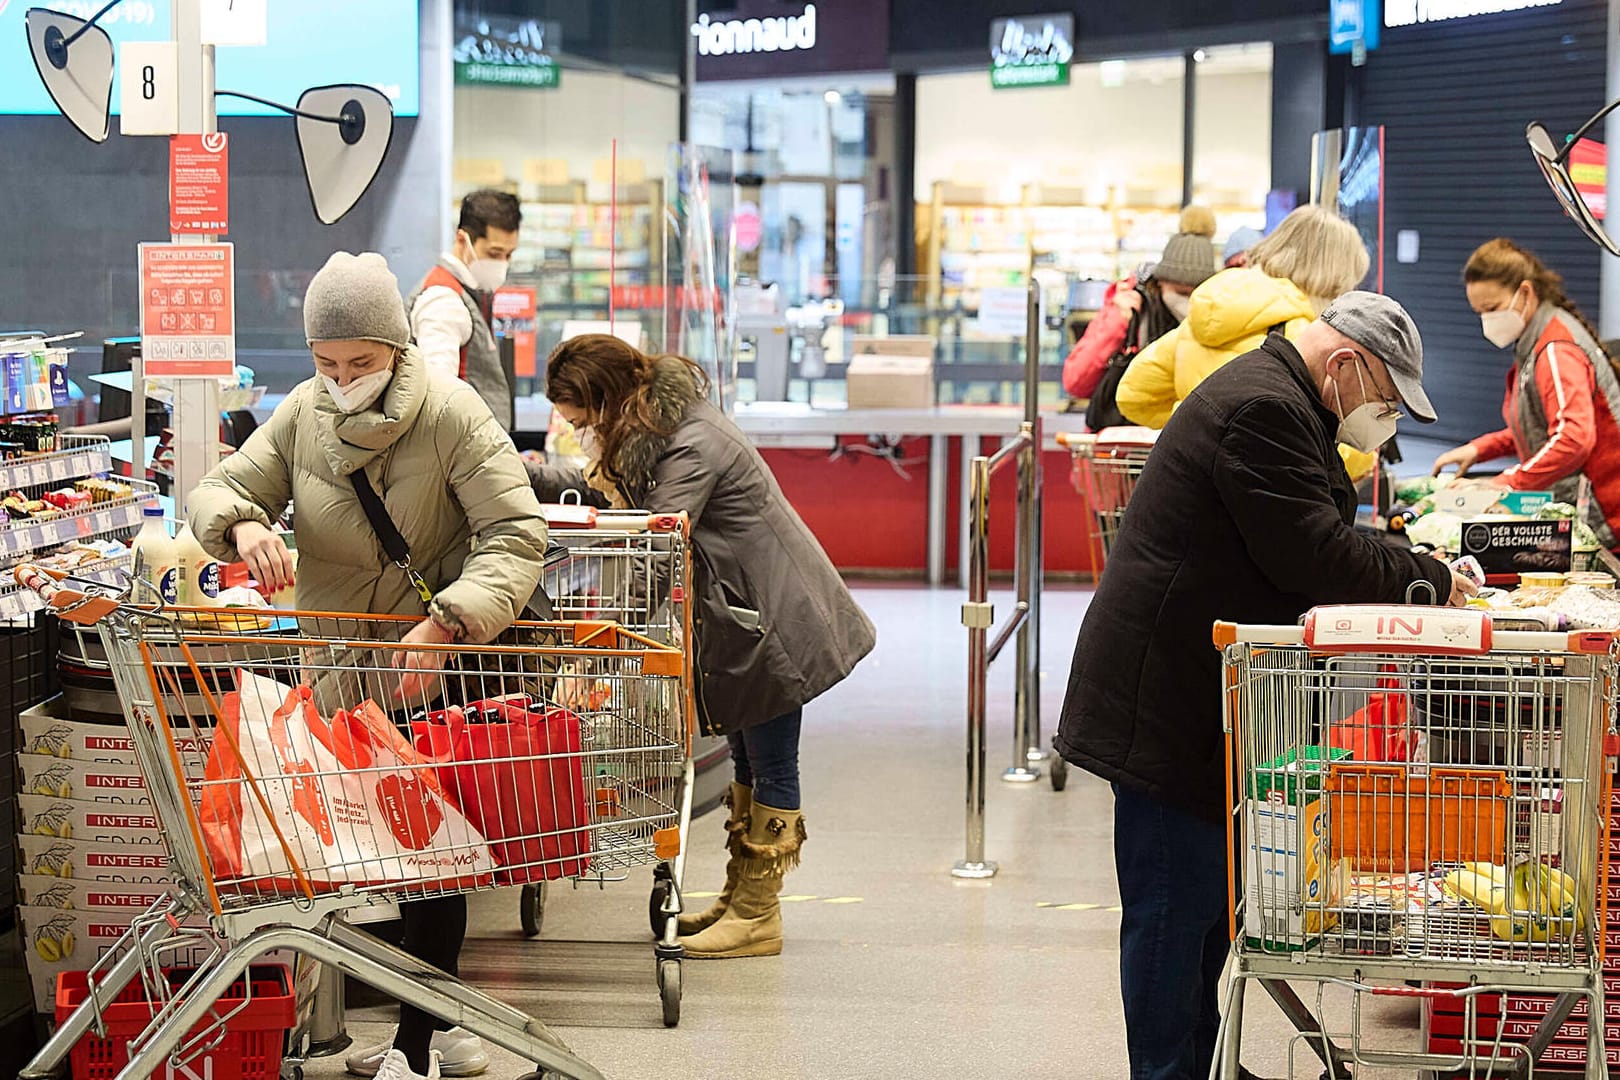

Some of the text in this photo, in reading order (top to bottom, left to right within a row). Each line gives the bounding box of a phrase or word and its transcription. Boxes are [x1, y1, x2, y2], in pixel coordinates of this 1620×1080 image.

[691, 4, 816, 55] ionnaud
[142, 65, 155, 99] 8
[1492, 526, 1510, 536] DER
[1513, 525, 1552, 535] VOLLSTE
[1377, 617, 1422, 635] IN
[97, 816, 156, 827] INTER
[98, 856, 168, 867] INTERS
